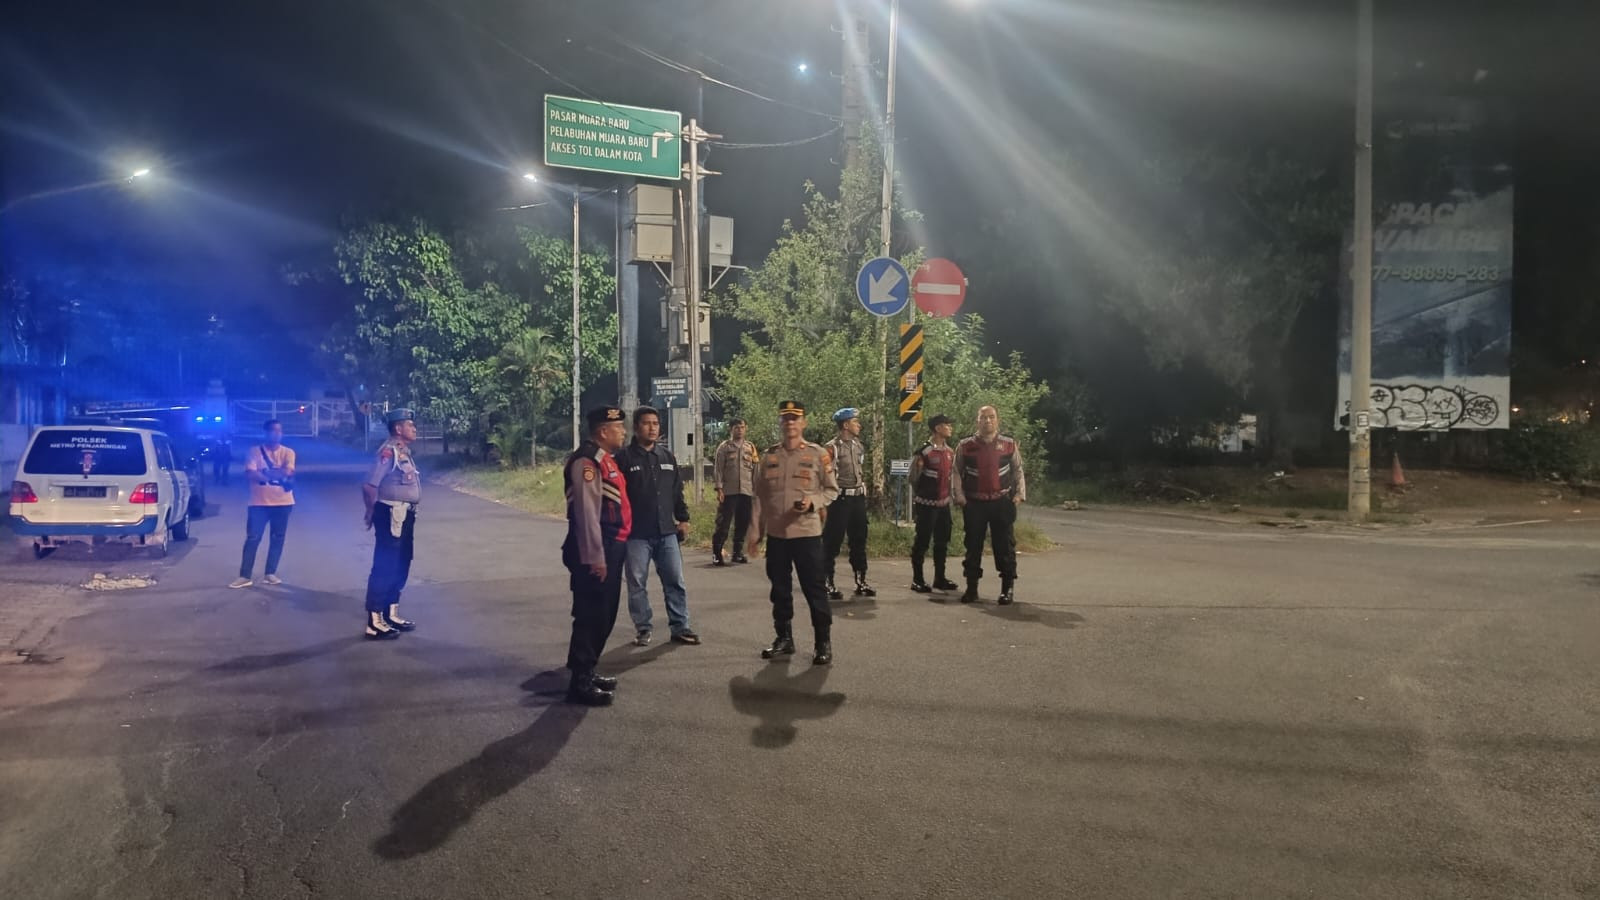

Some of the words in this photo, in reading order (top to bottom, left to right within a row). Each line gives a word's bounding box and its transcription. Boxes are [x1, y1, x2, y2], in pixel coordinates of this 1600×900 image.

[550, 109, 577, 122] PASAR
[578, 113, 606, 126] MUARA
[608, 118, 630, 130] BARU
[550, 125, 597, 141] PELABUHAN
[598, 131, 626, 145] MUARA
[628, 136, 649, 148] BARU
[550, 141, 577, 154] AKSES
[578, 145, 593, 157] TOL
[594, 147, 622, 160] DALAM
[623, 151, 643, 162] KOTA
